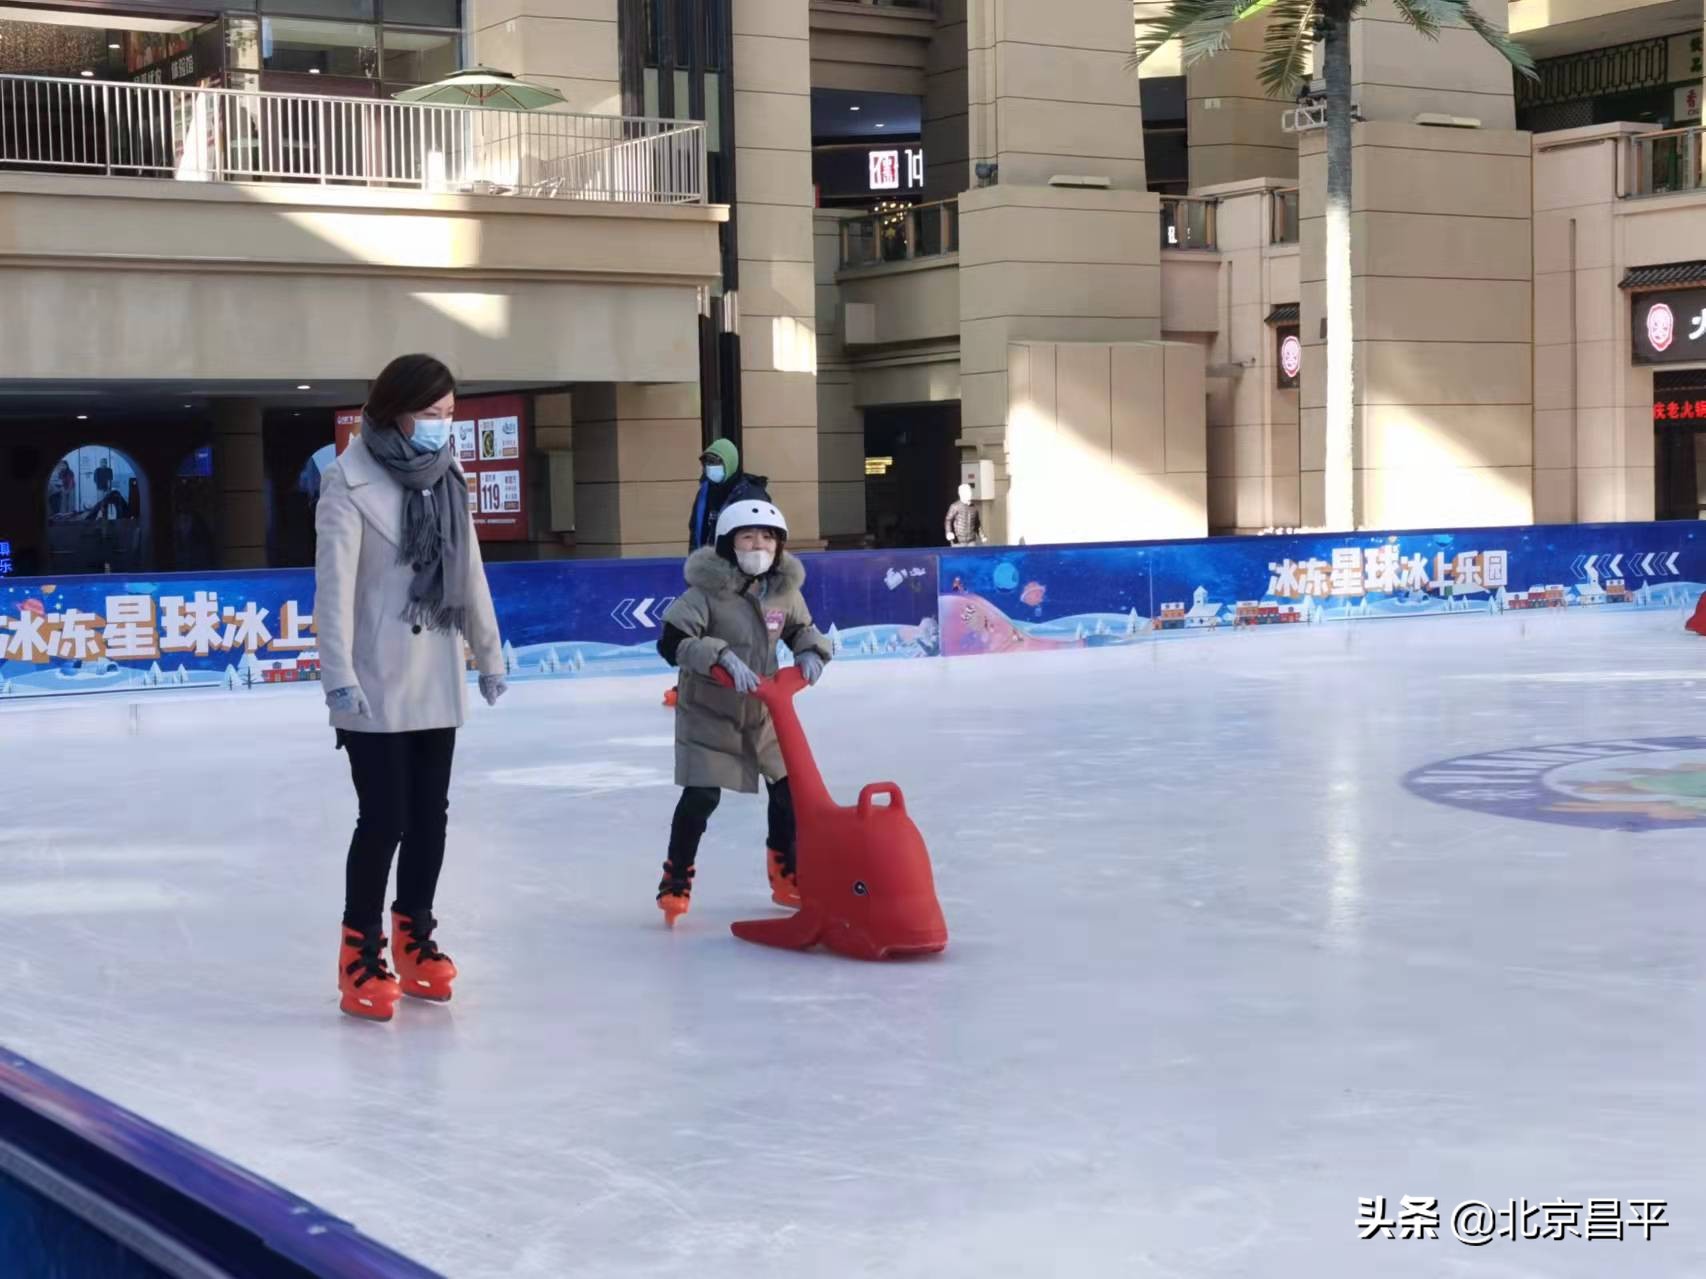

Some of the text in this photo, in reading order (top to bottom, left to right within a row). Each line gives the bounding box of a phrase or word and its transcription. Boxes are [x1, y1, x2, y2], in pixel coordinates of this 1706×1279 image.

[482, 483, 500, 510] 119
[1267, 545, 1509, 597] 冰冻星球冰上乐园
